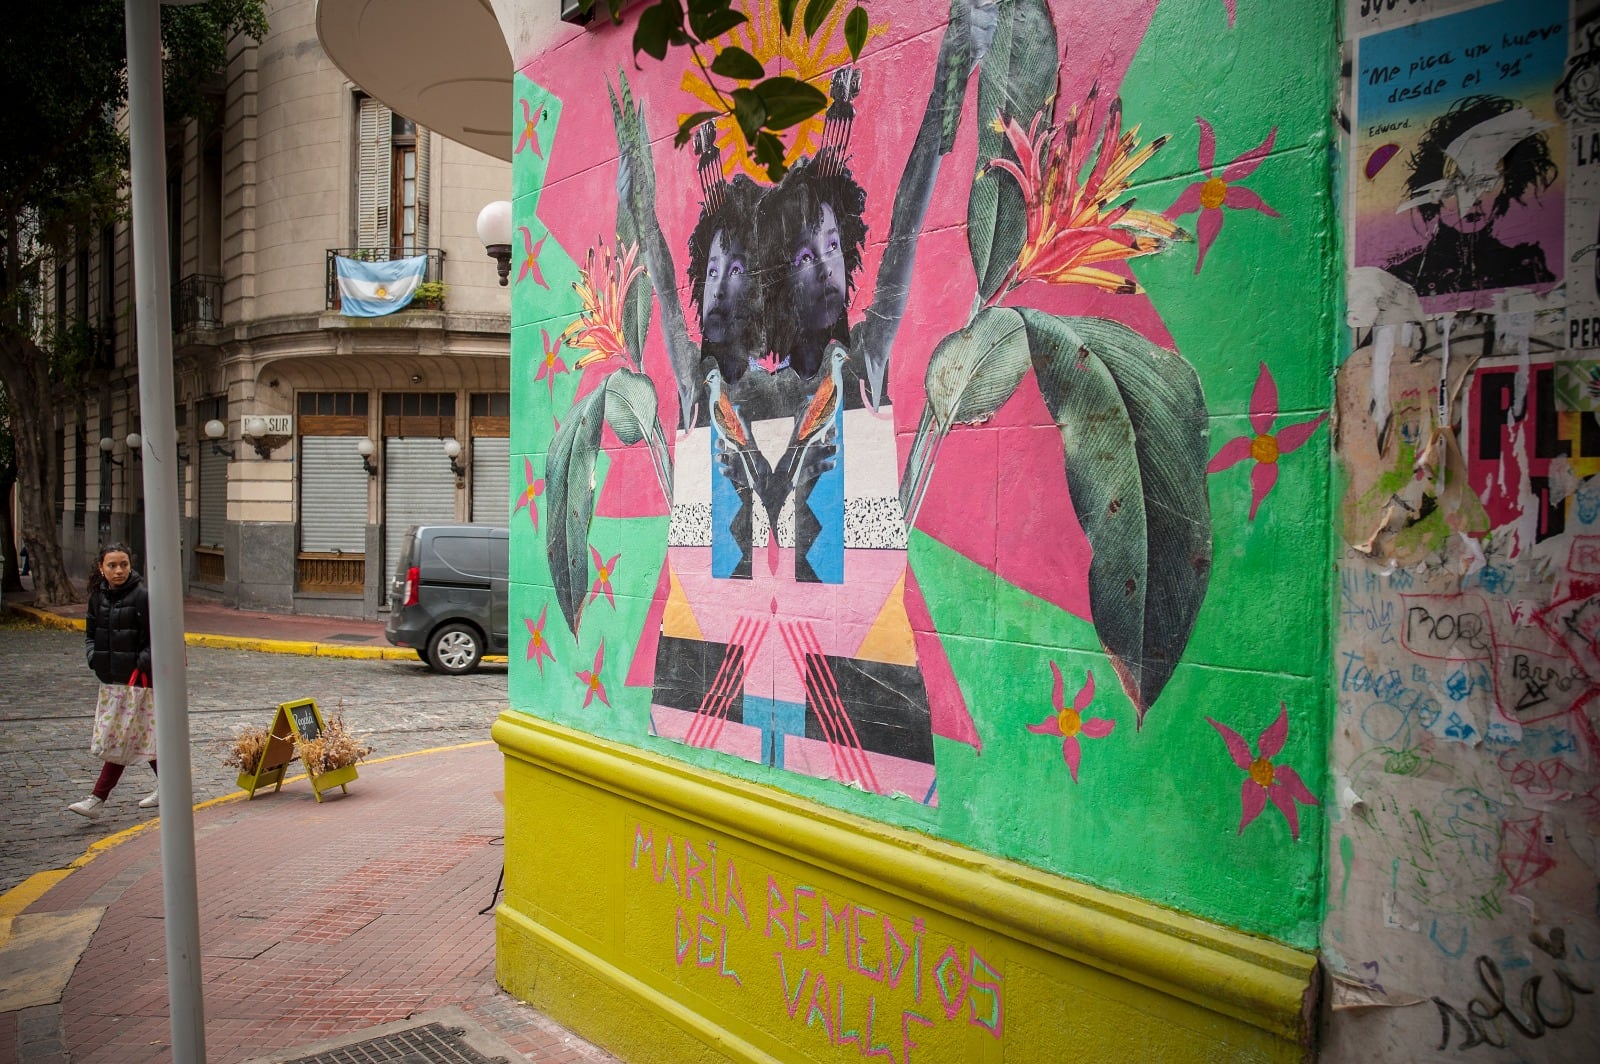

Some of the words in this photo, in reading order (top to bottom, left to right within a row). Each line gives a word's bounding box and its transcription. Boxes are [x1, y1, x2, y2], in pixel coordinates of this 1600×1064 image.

[1464, 41, 1493, 58] un
[1501, 23, 1564, 50] huevo
[1387, 78, 1447, 104] desde
[1461, 68, 1481, 89] el
[268, 418, 289, 432] SUR
[675, 906, 743, 988] DEL
